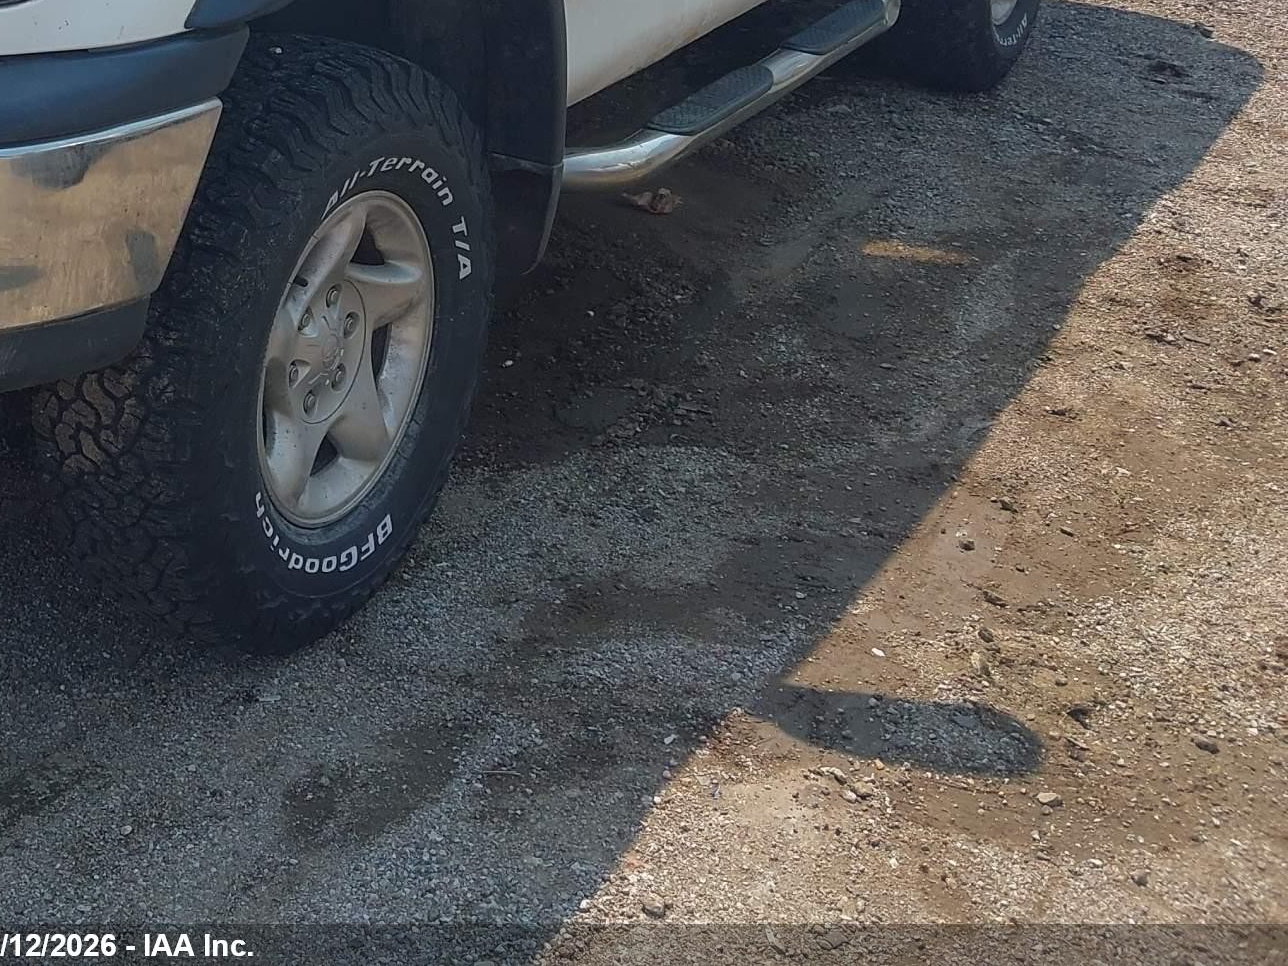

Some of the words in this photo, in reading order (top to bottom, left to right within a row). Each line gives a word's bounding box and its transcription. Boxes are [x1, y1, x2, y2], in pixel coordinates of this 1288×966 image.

[320, 156, 455, 221] All-Terrain
[451, 216, 473, 280] T/A
[255, 491, 393, 574] BFGoodrich
